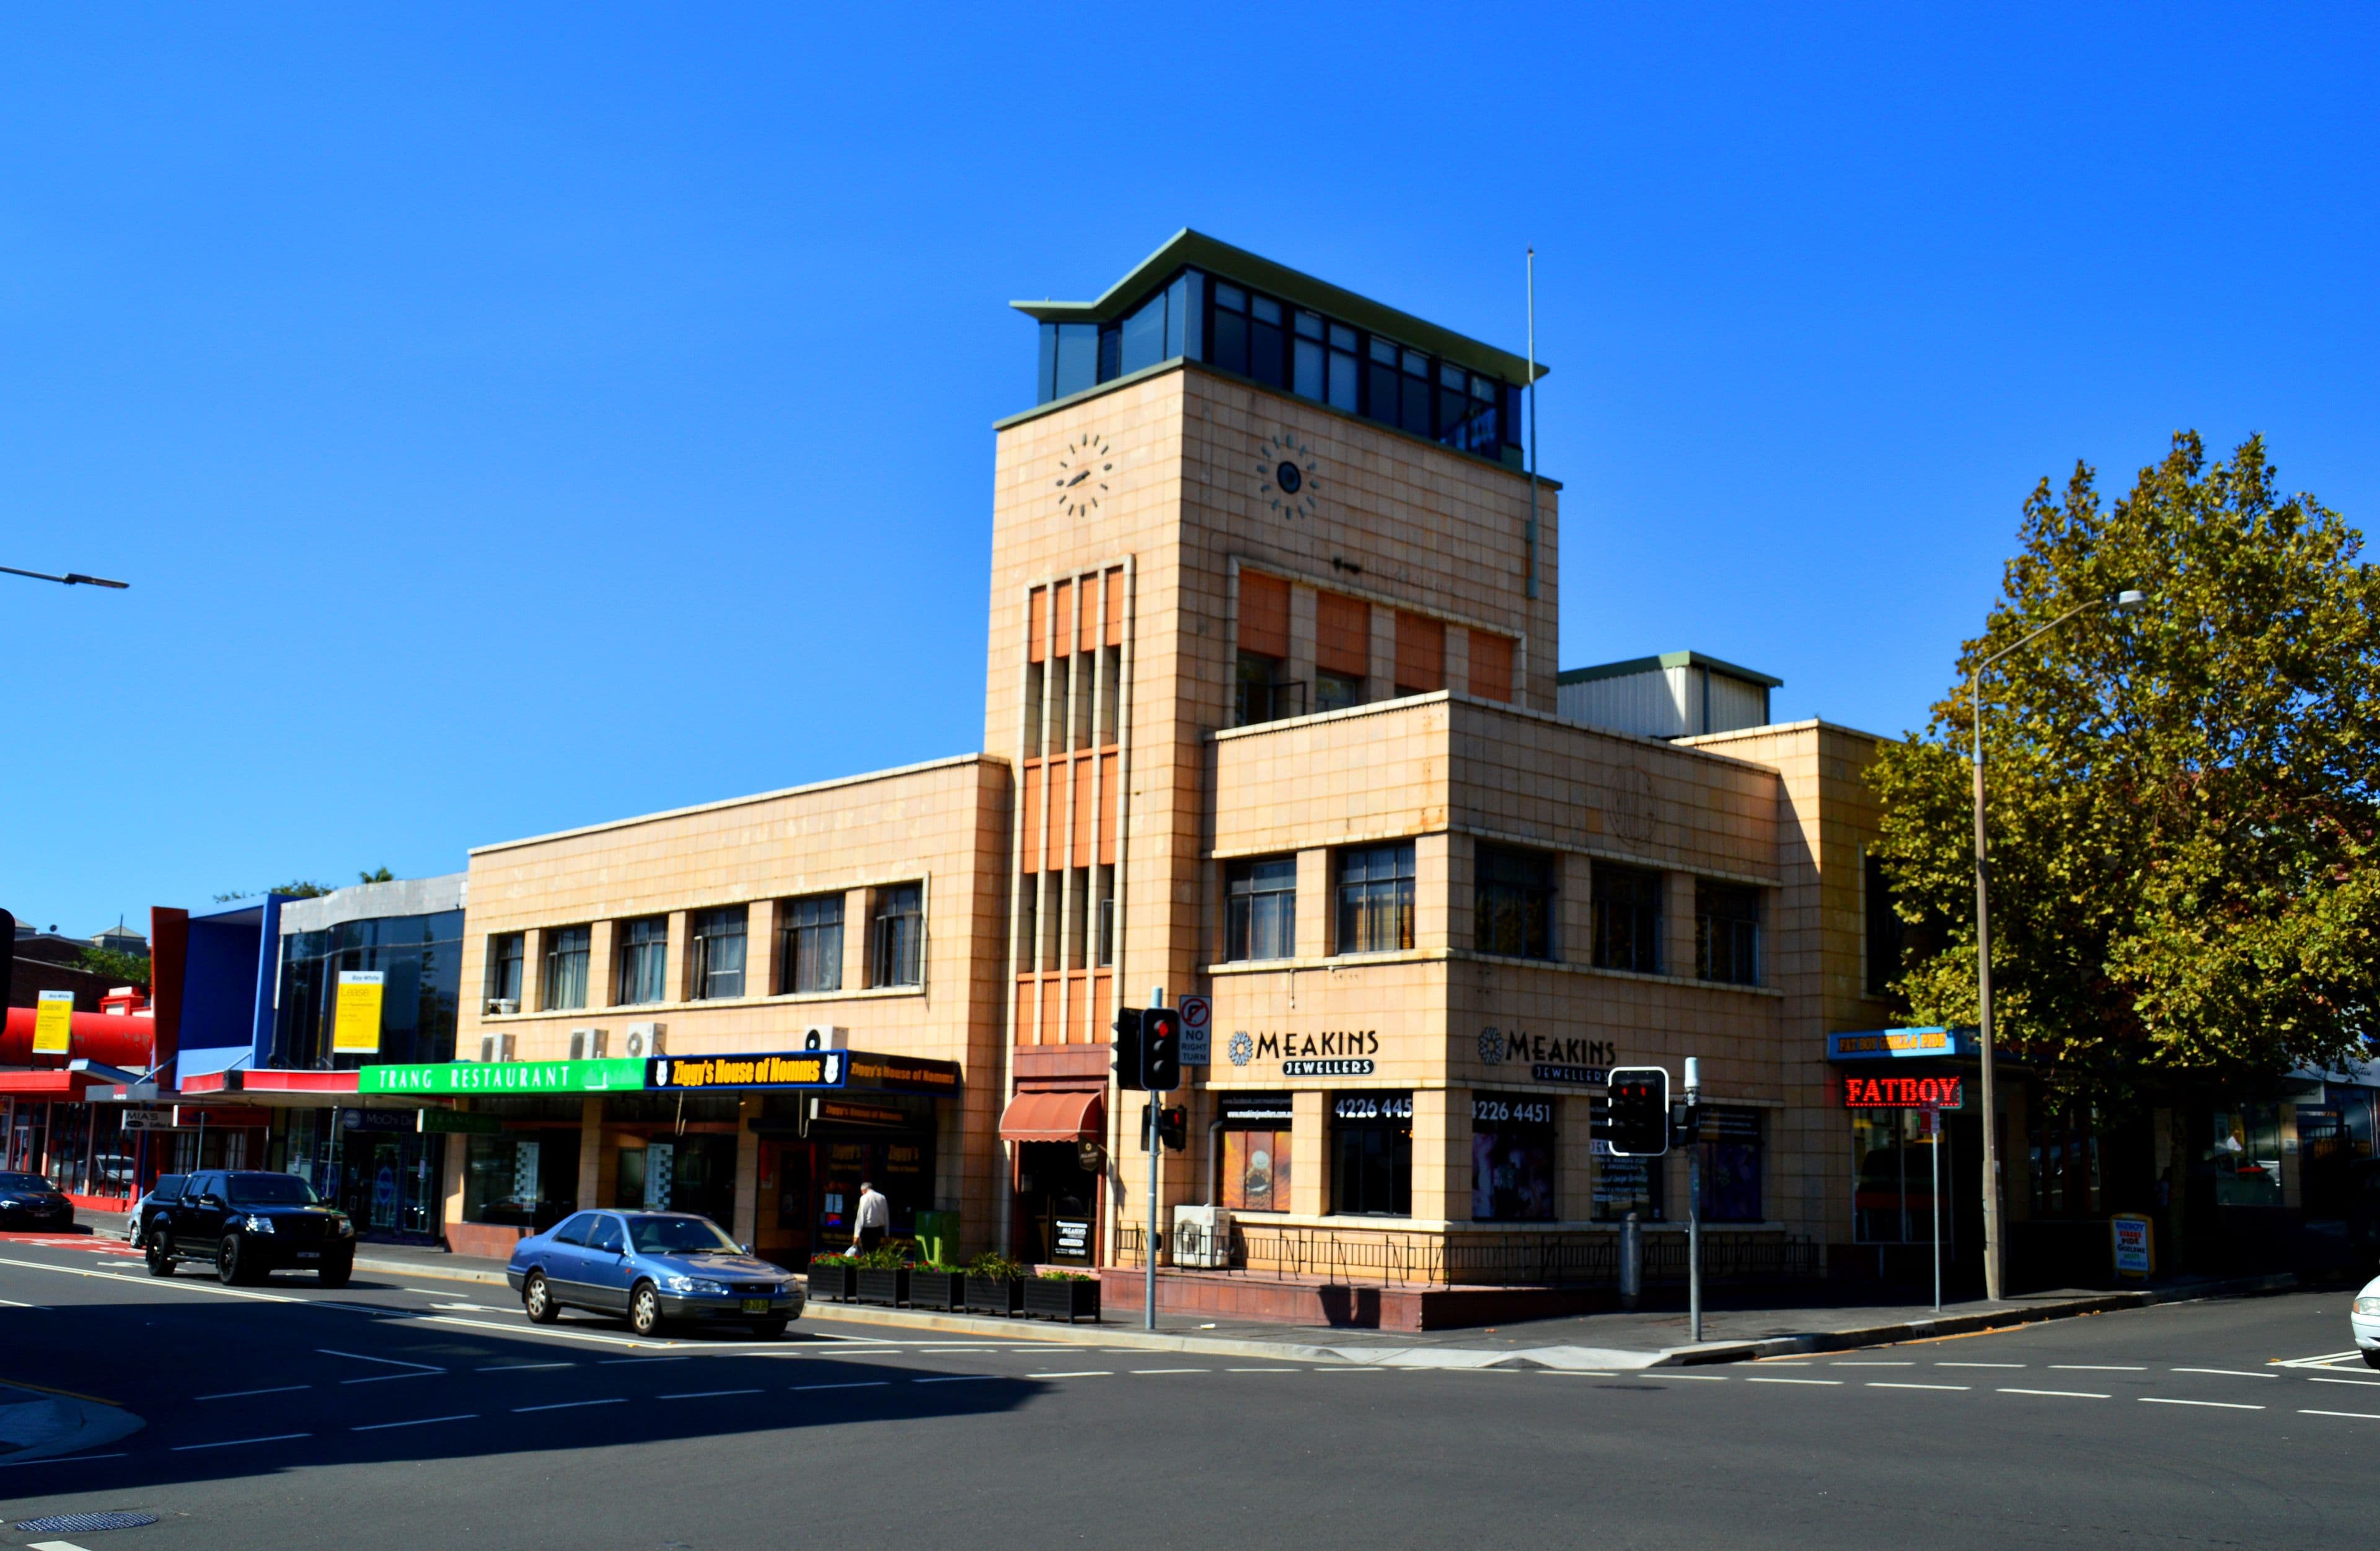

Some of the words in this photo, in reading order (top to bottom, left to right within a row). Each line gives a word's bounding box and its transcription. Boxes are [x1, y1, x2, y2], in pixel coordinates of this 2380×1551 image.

[341, 986, 369, 997] Lease
[40, 1002, 62, 1011] Lease
[1186, 1030, 1204, 1041] NO
[1256, 1030, 1378, 1059] MEAKINS
[1838, 1037, 1857, 1053] FAT
[1858, 1036, 1877, 1052] BOY
[1879, 1035, 1909, 1050] GRILL
[1919, 1032, 1947, 1049] PIDE
[1181, 1043, 1207, 1052] RIGHT
[1183, 1053, 1207, 1061] TURN
[1505, 1030, 1616, 1066] MEAKINS
[672, 1059, 714, 1087] Ziggy's
[715, 1059, 754, 1084] House
[755, 1058, 770, 1083] of
[770, 1057, 821, 1082] Nomms
[850, 1061, 883, 1078] Ziggy's
[883, 1066, 911, 1081] House
[912, 1069, 921, 1080] of
[922, 1069, 956, 1085] Nomms
[1285, 1061, 1370, 1074] JEWELLERS
[1536, 1066, 1609, 1084] JEWELLERS
[379, 1069, 432, 1089] TRANG
[451, 1066, 570, 1088] RESTAURANT
[1846, 1079, 1957, 1102] FATBOY
[126, 1111, 158, 1121] MIA'S
[1335, 1098, 1378, 1118] 4226
[1381, 1098, 1413, 1118] 445
[1513, 1102, 1551, 1123] 4451
[401, 1114, 417, 1127] Din
[887, 1143, 920, 1162] Ziggy's
